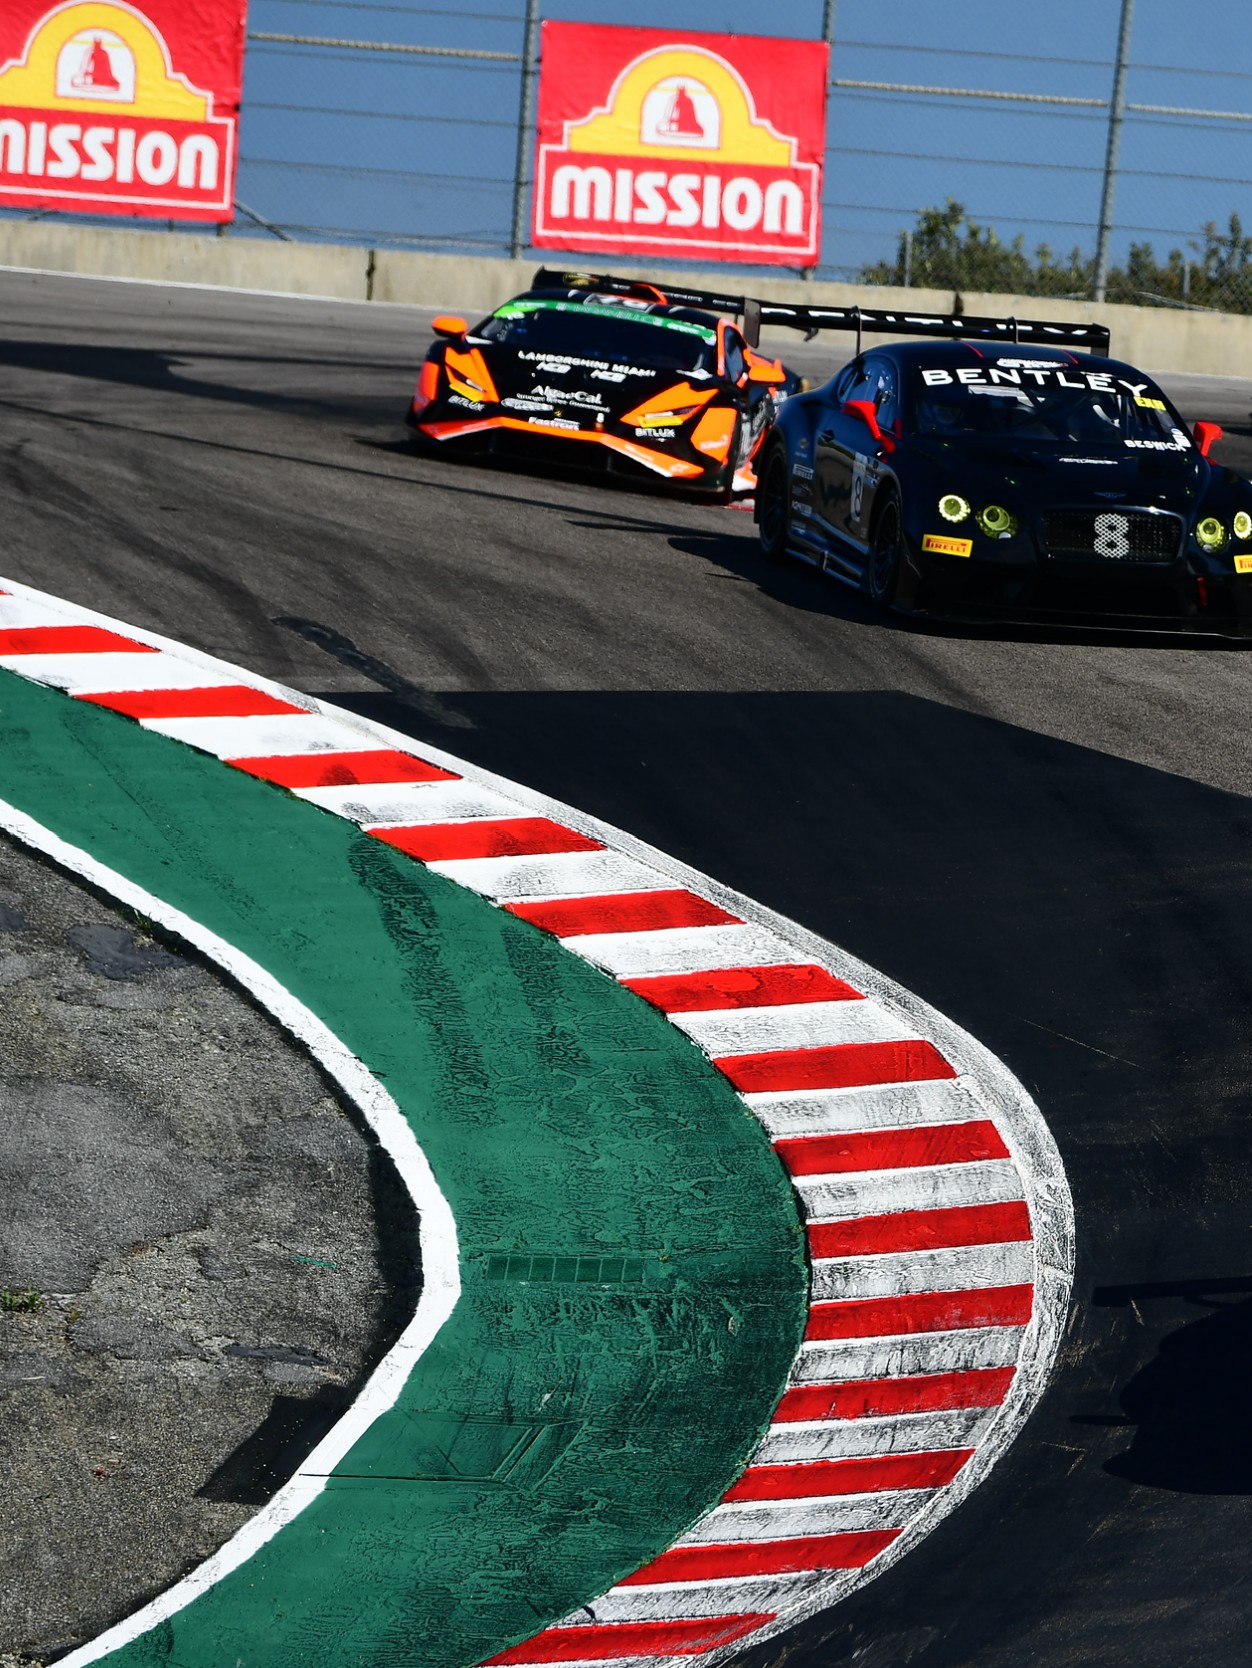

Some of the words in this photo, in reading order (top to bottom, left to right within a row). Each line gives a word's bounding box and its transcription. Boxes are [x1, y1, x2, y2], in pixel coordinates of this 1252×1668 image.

[550, 164, 804, 235] MISSION
[517, 350, 610, 370] LAMBORGHINI
[611, 363, 657, 377] MIAMI
[921, 368, 1148, 398] BENTLEY
[634, 427, 676, 438] BITLUX
[1123, 439, 1188, 452] BESWICK
[926, 537, 968, 553] PIRELLI
[1094, 512, 1130, 559] 8
